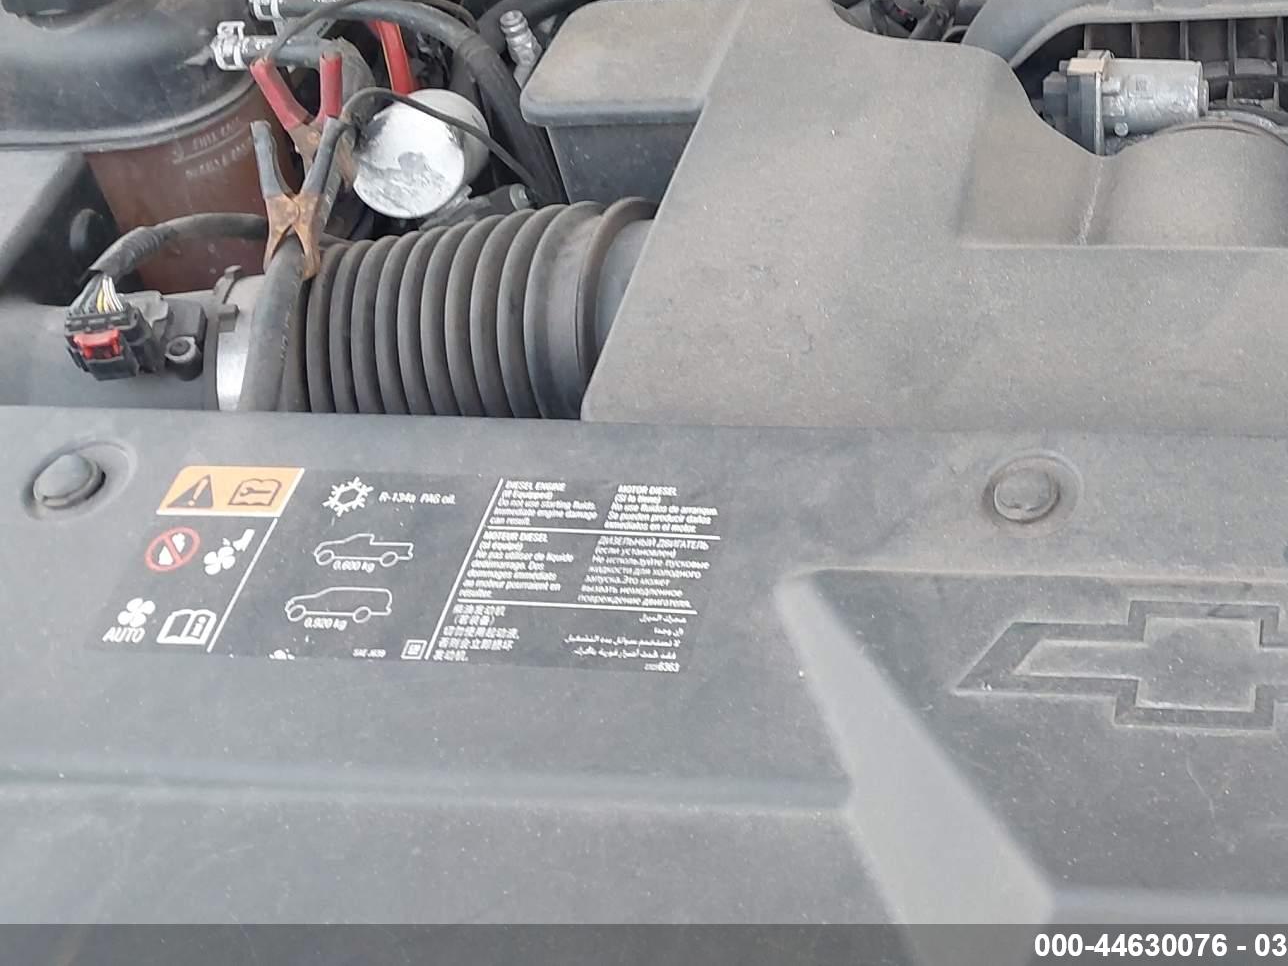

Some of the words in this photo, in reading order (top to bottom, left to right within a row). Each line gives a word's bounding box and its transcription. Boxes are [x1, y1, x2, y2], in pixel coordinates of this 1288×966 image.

[504, 480, 533, 490] DIESEL
[534, 481, 566, 492] ENGINE
[617, 484, 649, 494] MOTOR
[648, 486, 677, 496] DIESEL
[497, 497, 509, 507] Do
[509, 499, 524, 508] not
[524, 500, 540, 508] use
[540, 500, 572, 511] starting
[610, 502, 624, 512] No
[624, 504, 640, 512] use
[640, 504, 668, 514] fluidos
[668, 505, 680, 514] de
[489, 517, 505, 525] can
[536, 509, 565, 519] engine
[564, 511, 598, 521] damage
[619, 512, 650, 522] pueden
[482, 530, 519, 541] MOTEUR
[518, 532, 549, 543] DIESEL
[656, 538, 710, 551] ДВИГАТЕЛЬ
[101, 626, 146, 643] AUTO
